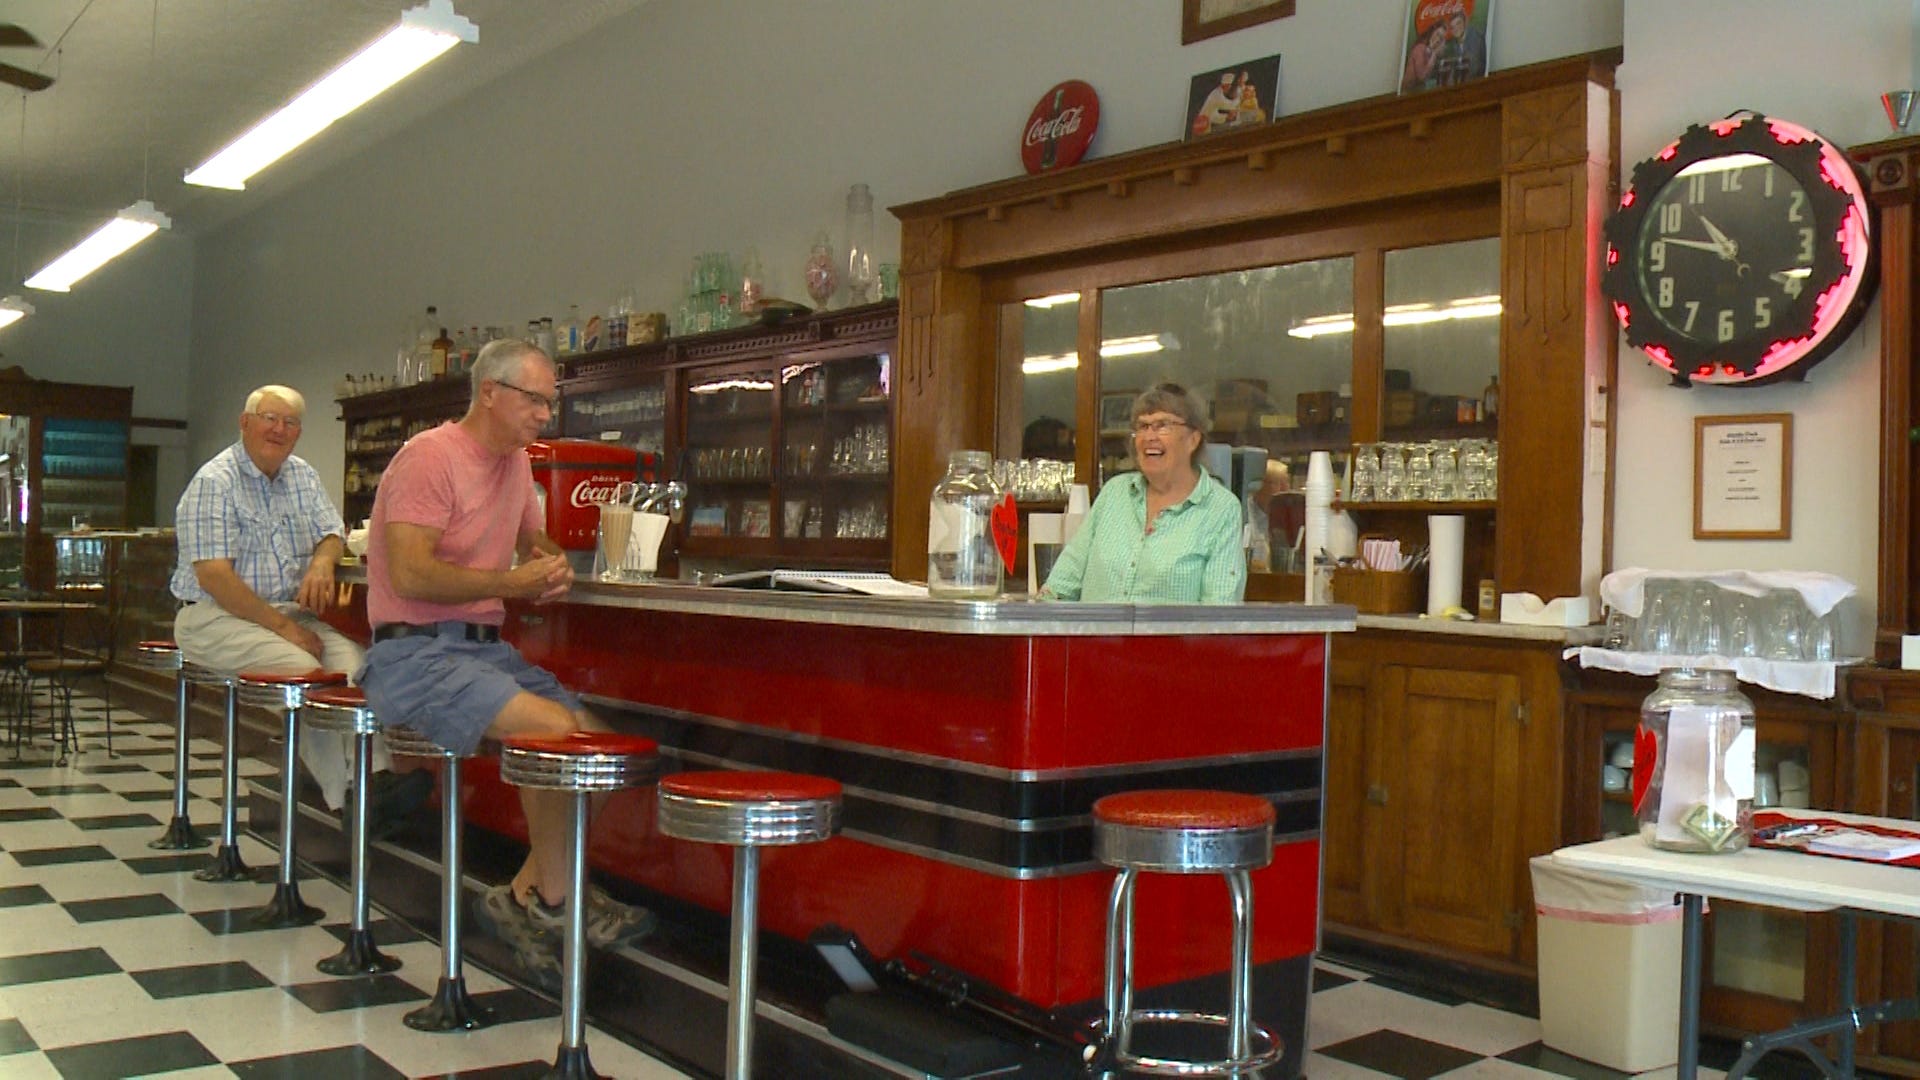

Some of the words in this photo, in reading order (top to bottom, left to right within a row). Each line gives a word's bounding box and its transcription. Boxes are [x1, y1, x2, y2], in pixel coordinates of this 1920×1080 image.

[1689, 174, 1705, 204] 11
[1722, 168, 1743, 192] 12
[1765, 166, 1774, 197] 1
[1660, 203, 1682, 233] 10
[1789, 191, 1805, 222] 2
[1650, 241, 1666, 272] 9
[1798, 228, 1814, 261] 3
[1659, 277, 1674, 308] 8
[1784, 273, 1803, 300] 4
[1684, 301, 1700, 332] 7
[1718, 309, 1734, 343] 6
[1755, 297, 1771, 328] 5
